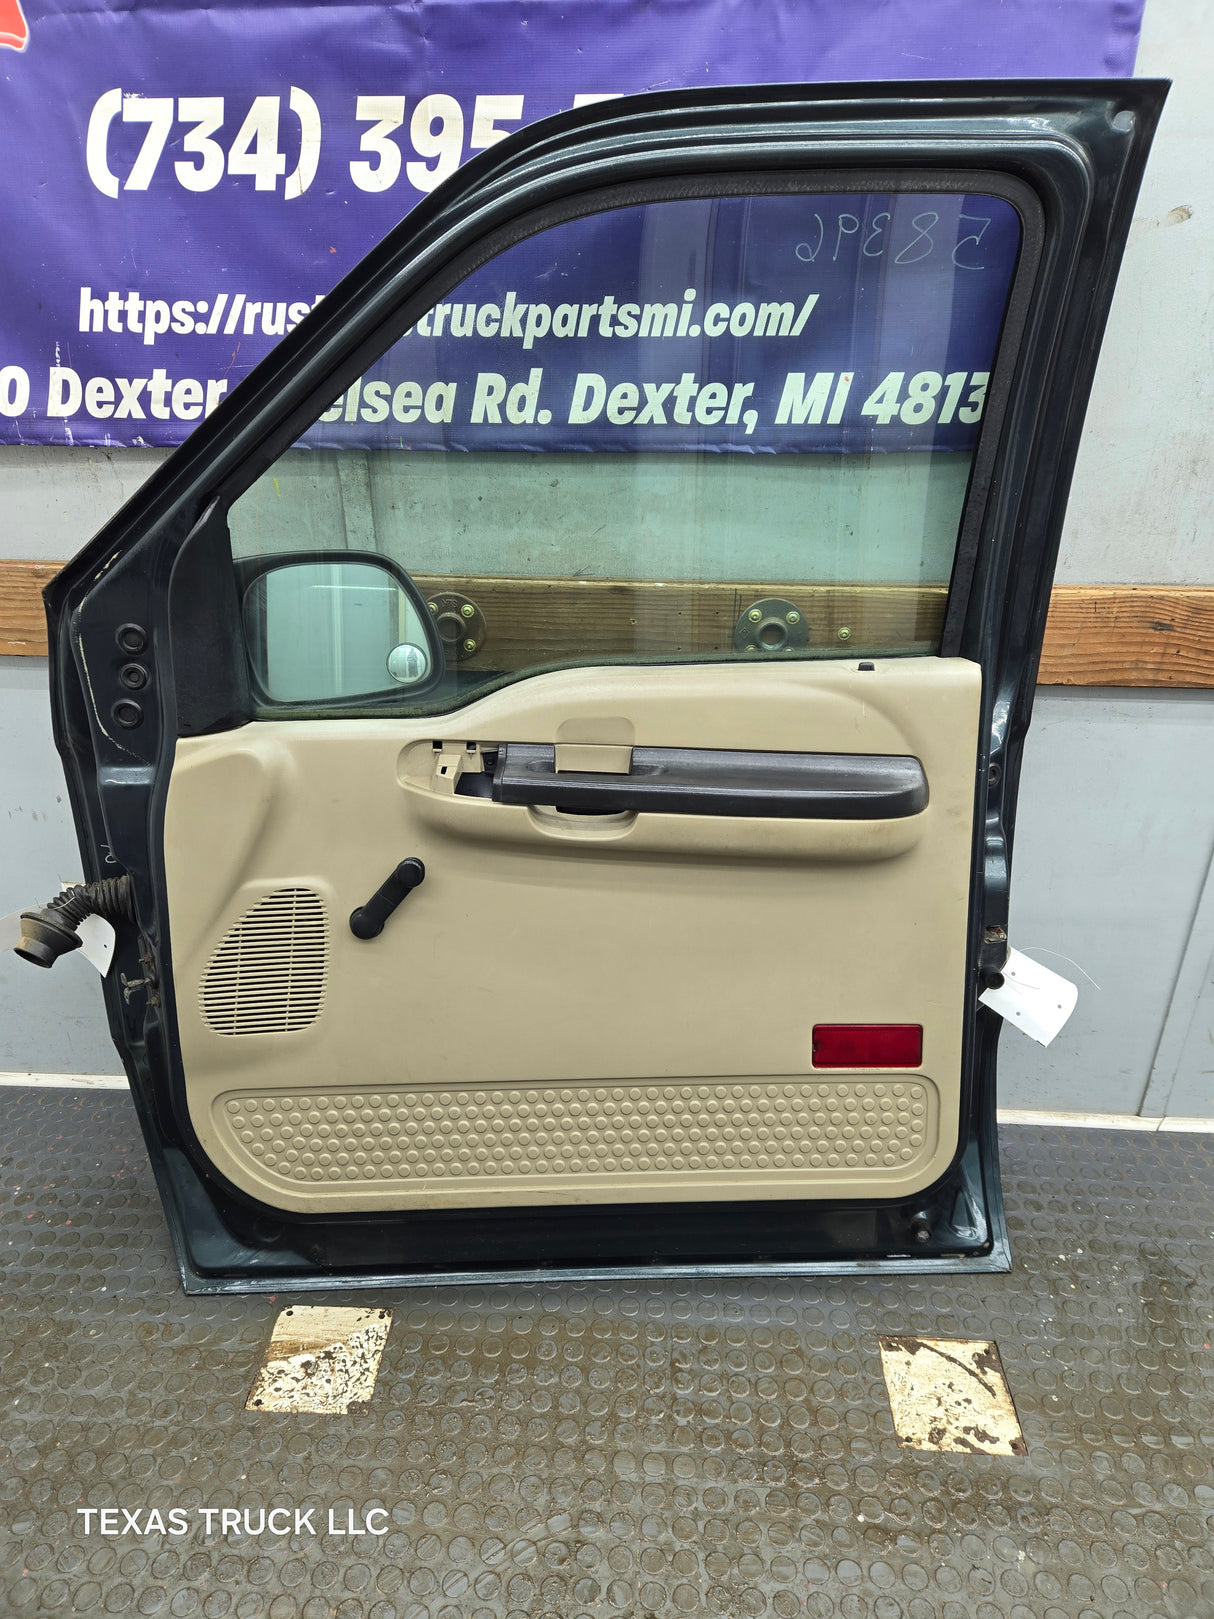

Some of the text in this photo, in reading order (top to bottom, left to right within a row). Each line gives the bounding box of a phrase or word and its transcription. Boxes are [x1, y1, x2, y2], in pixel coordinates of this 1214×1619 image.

[86, 86, 625, 200] (734) 395
[47, 366, 228, 421] Dexter
[470, 368, 553, 425] Rd.
[568, 373, 759, 434] Dexter,
[774, 372, 855, 424] MI
